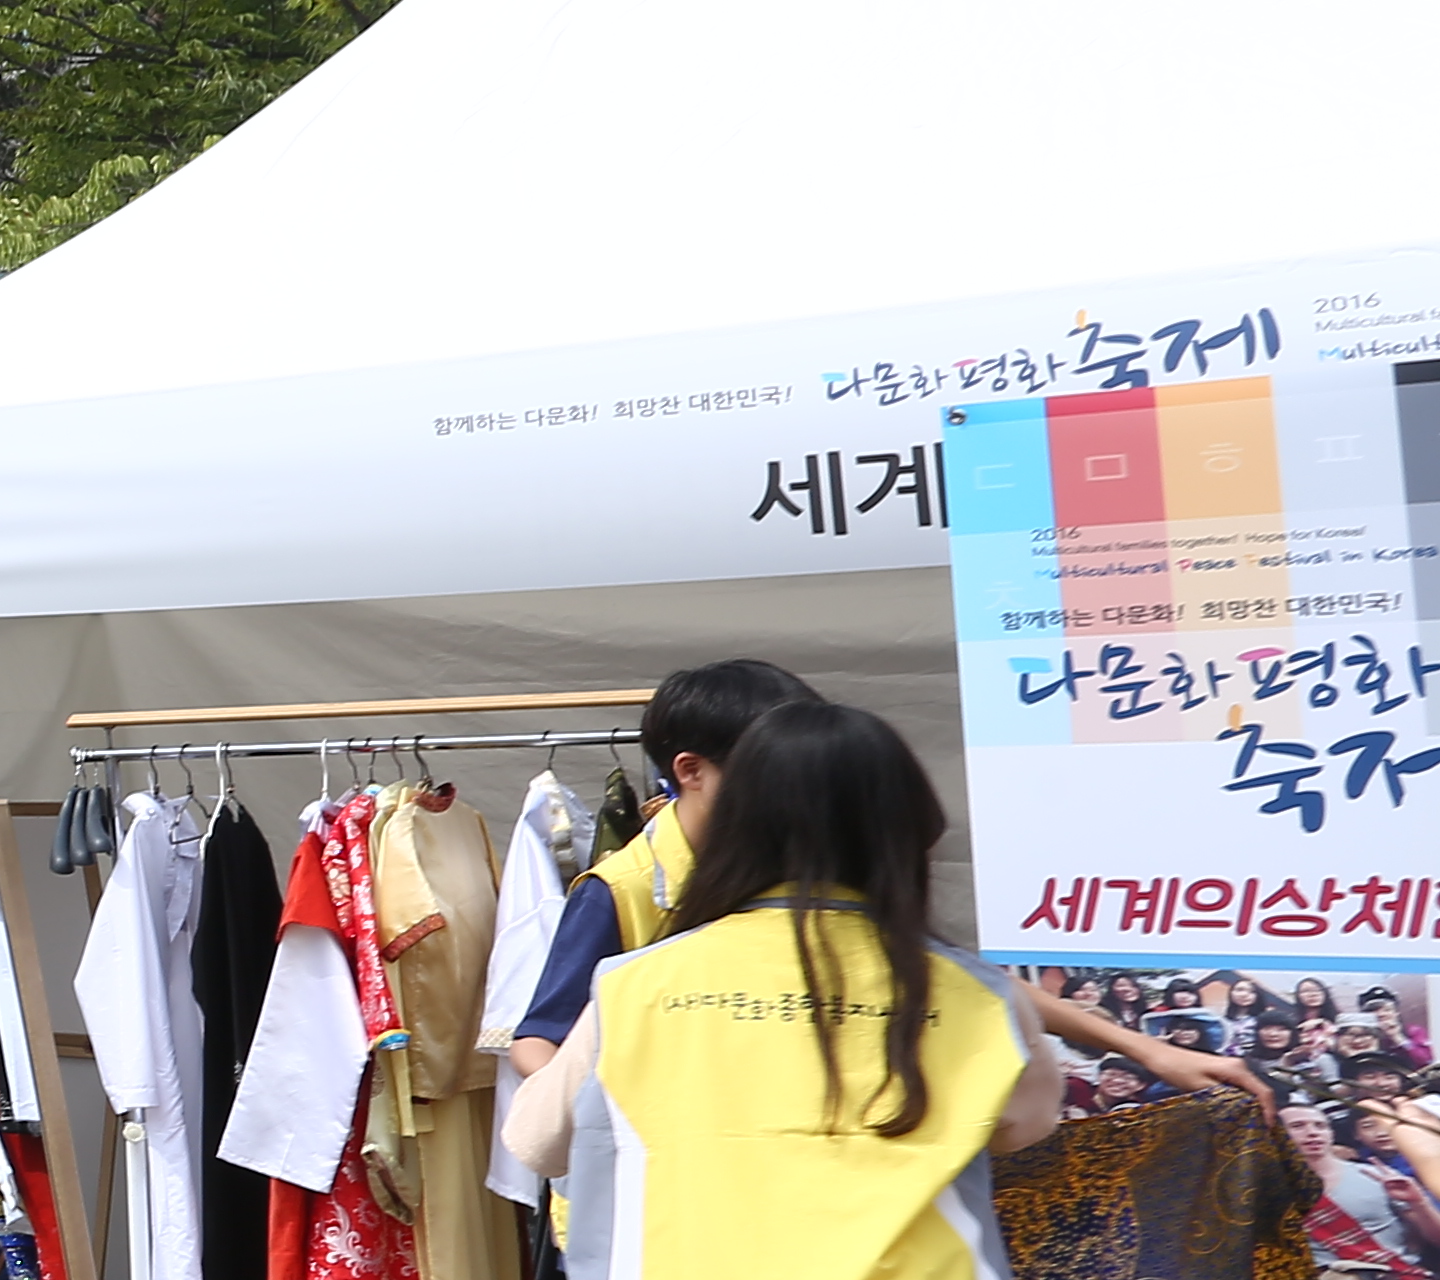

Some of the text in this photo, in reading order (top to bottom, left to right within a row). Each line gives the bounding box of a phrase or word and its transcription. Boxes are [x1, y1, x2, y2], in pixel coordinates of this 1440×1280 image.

[1313, 291, 1381, 314] 2016
[1067, 308, 1282, 388] 축제
[434, 385, 793, 436] 함께하는 다문화! 희망찬 대한민국!
[1030, 526, 1082, 542] 2016
[1032, 541, 1112, 556] Multicultural
[1034, 545, 1439, 580] Multicultural Peace Festival in Korea
[1000, 592, 1404, 631] 함께하는 다문화! 희망찬 대한민국!
[1019, 875, 1440, 939] 세계의상체
